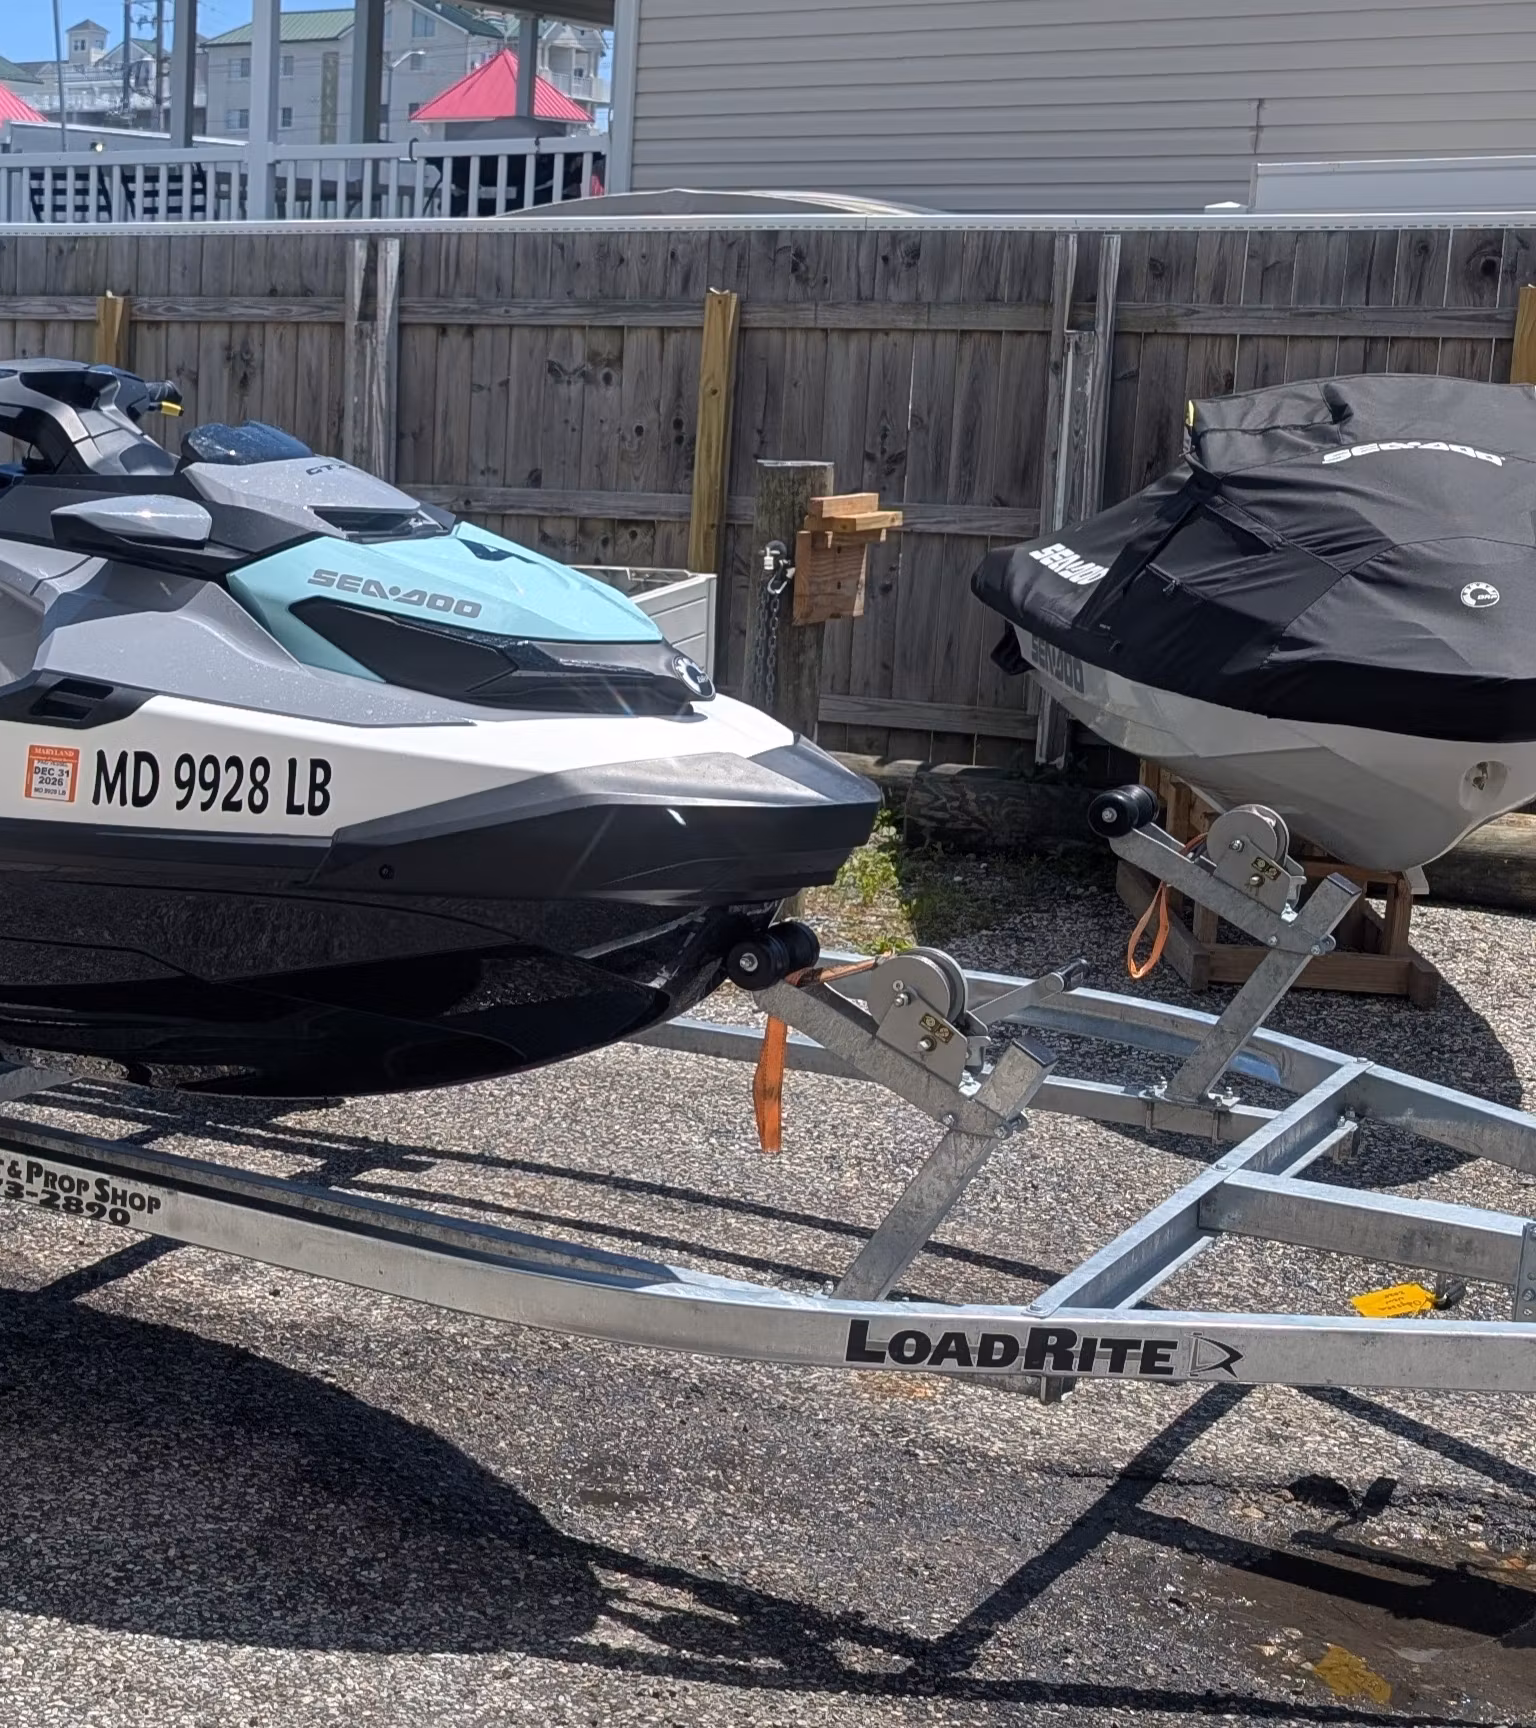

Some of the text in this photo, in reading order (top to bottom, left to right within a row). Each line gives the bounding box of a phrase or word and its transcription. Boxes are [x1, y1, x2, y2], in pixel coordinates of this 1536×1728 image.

[34, 748, 74, 757] MARYLAND
[34, 766, 69, 778] DEC 31
[38, 776, 63, 786] 2026
[92, 749, 331, 816] MD 9928 LB
[7, 1160, 22, 1179] &
[26, 1161, 89, 1196] PROP
[94, 1177, 161, 1214] SHOP
[845, 1319, 1179, 1375] LOADRITE
